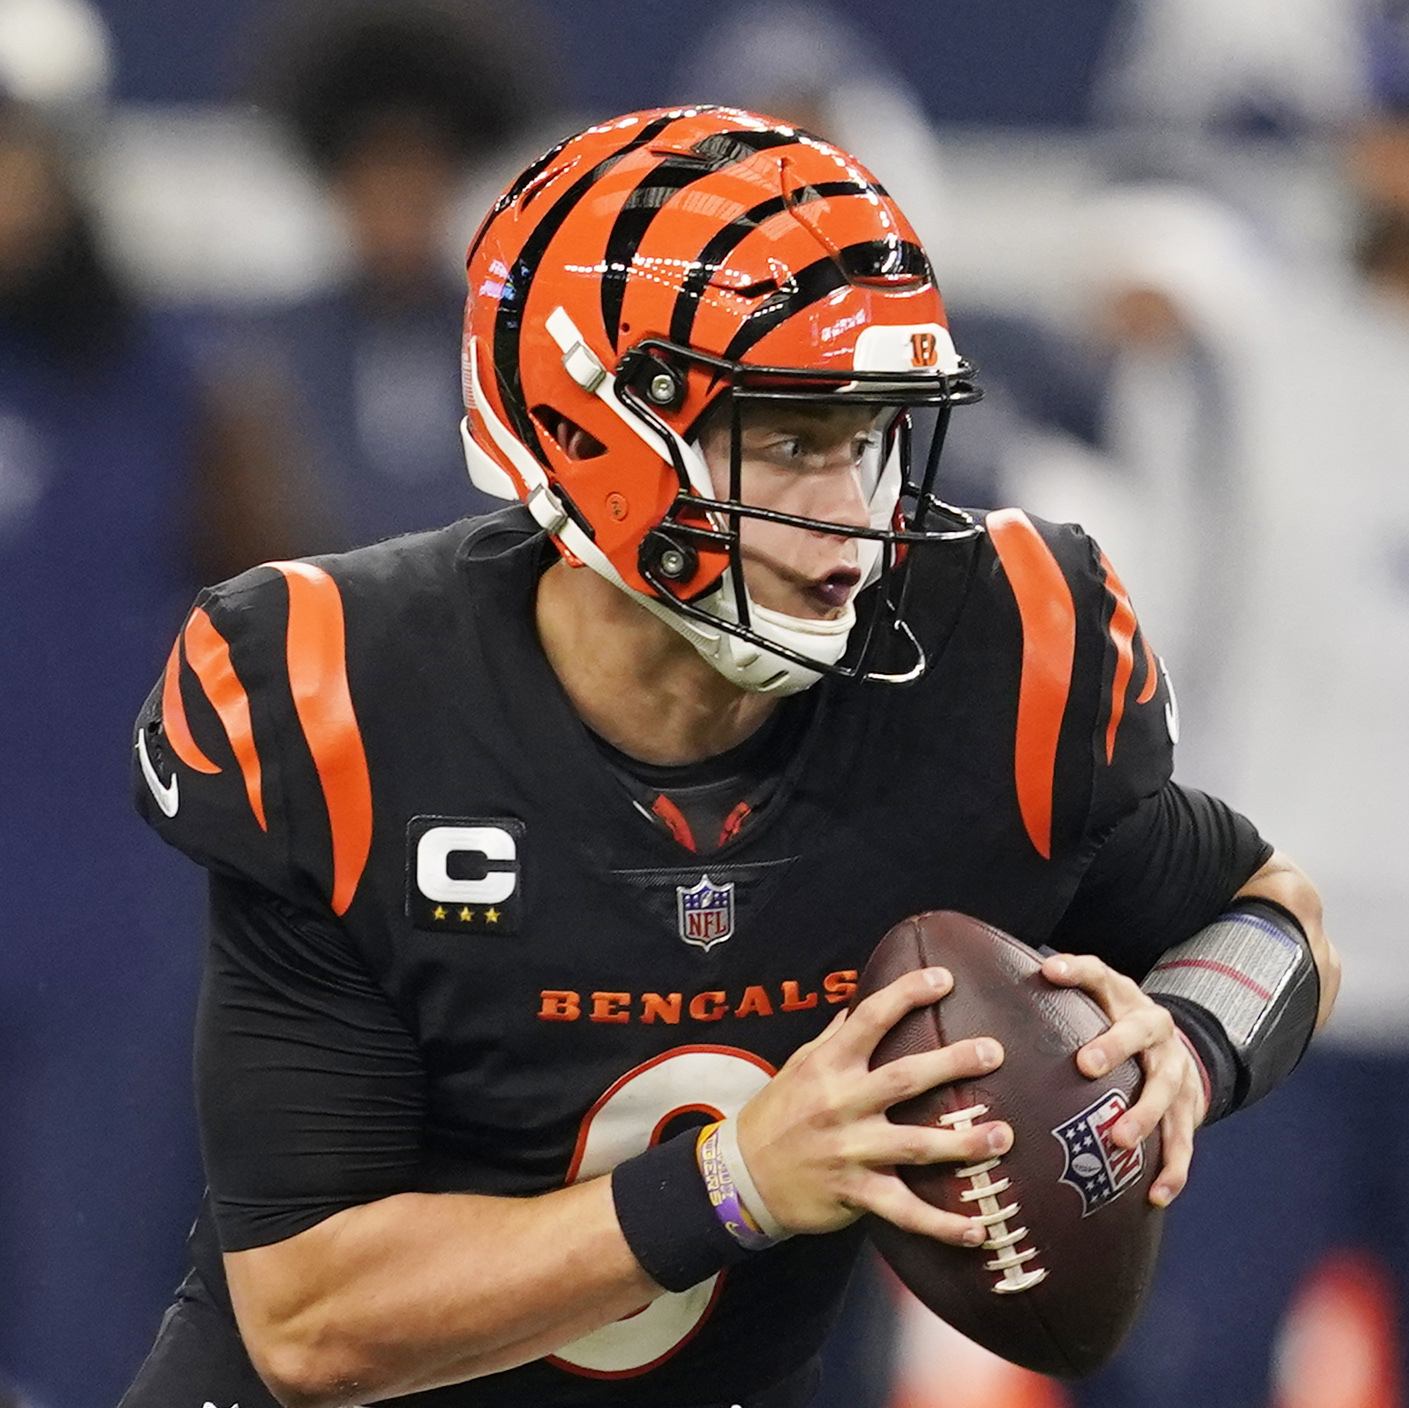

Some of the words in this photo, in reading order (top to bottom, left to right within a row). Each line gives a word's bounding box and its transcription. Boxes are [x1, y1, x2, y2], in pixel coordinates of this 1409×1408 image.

[416, 826, 516, 904] C
[688, 911, 727, 938] NFL
[537, 969, 858, 1024] BENGALS
